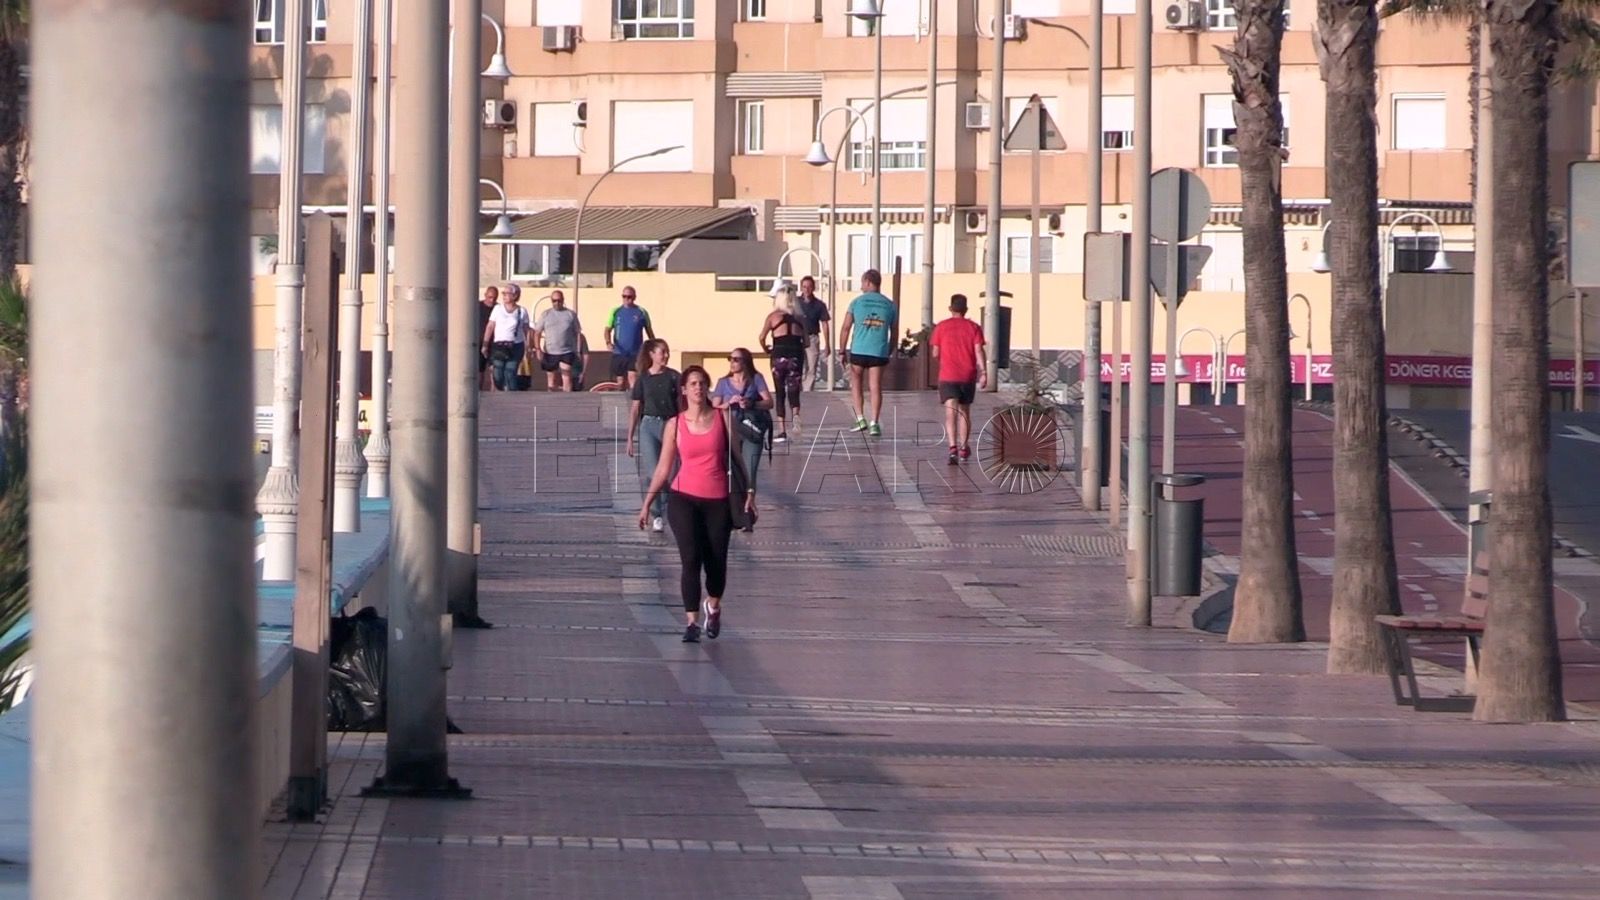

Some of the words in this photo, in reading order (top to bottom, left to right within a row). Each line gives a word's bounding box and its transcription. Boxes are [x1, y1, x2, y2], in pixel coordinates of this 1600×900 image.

[1310, 363, 1334, 377] PIZ
[1389, 360, 1441, 378] DÖNER
[1443, 364, 1474, 379] KEB
